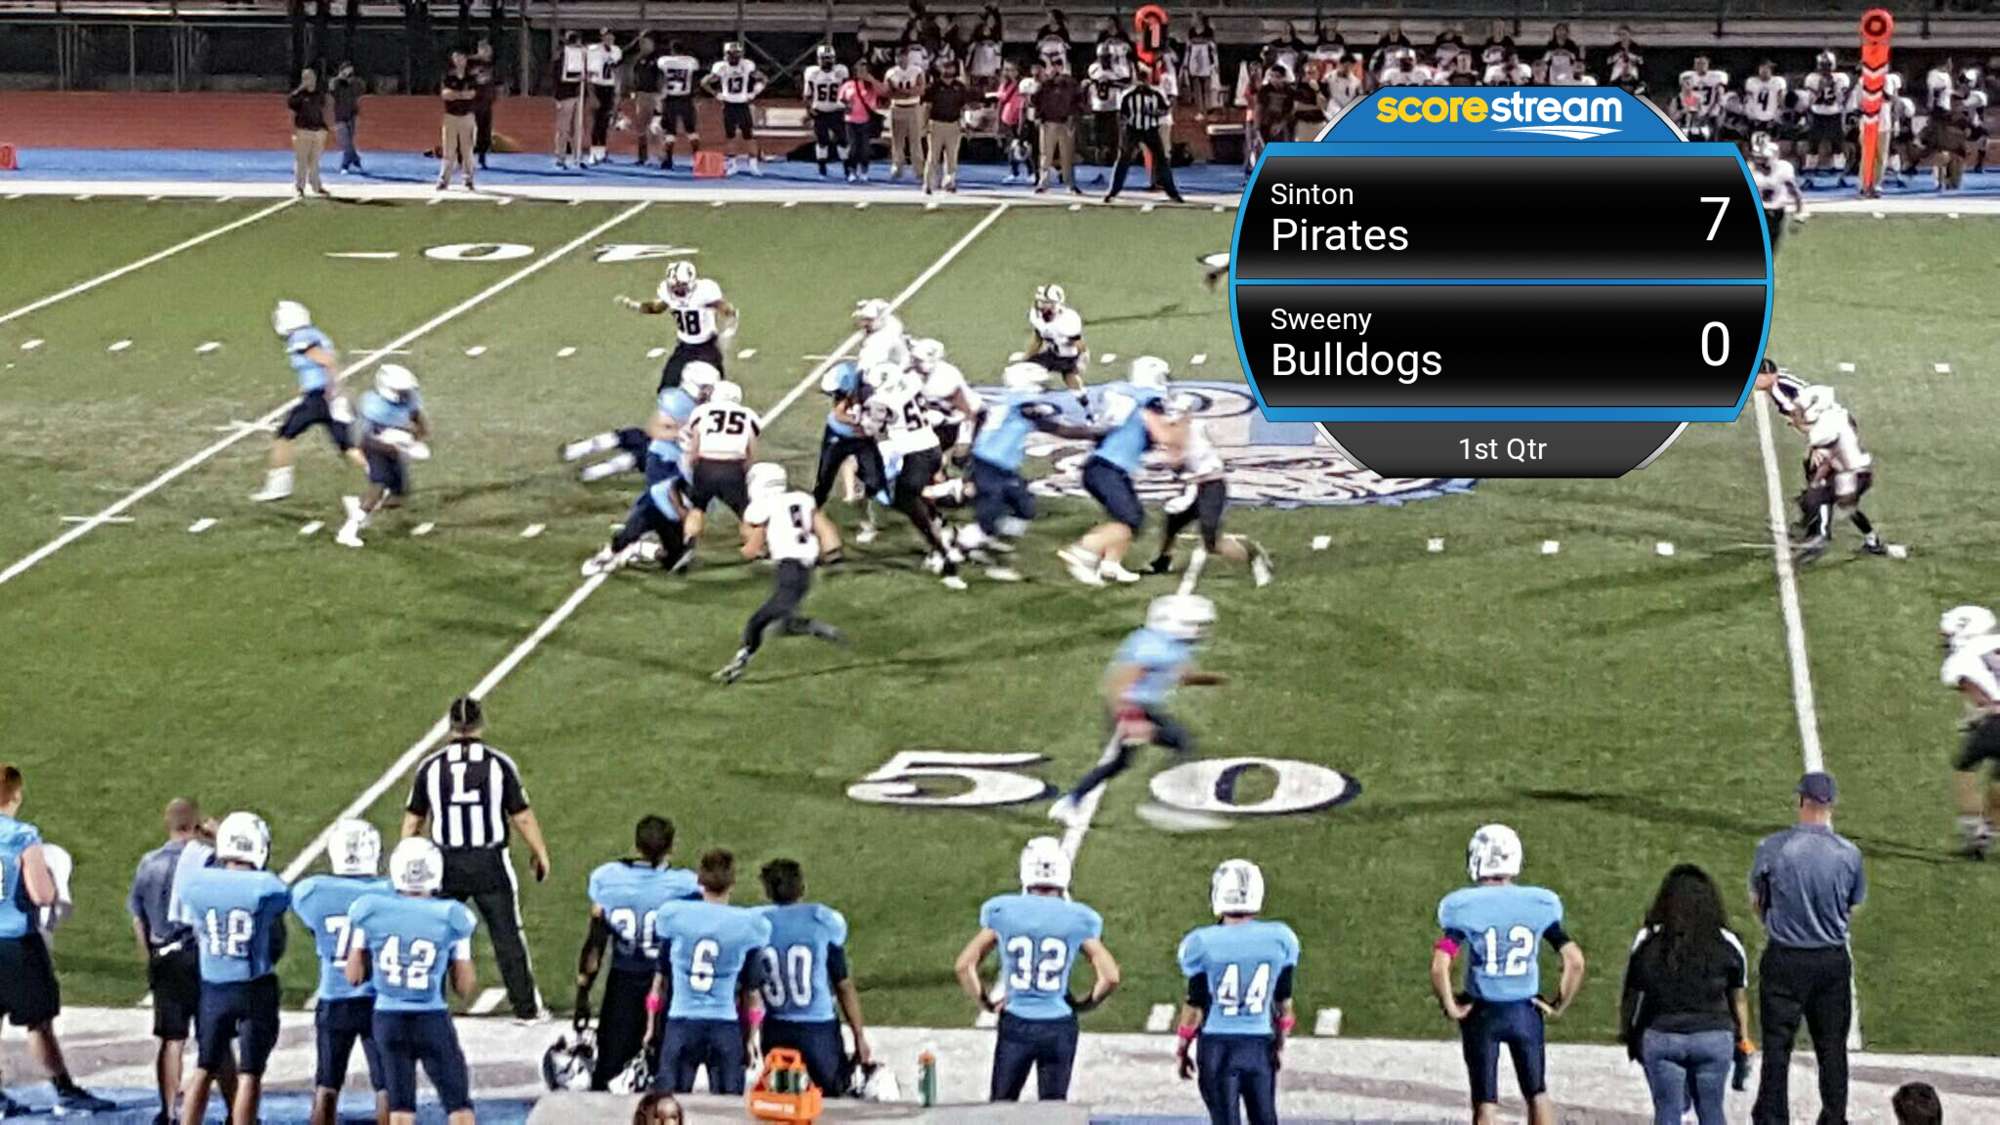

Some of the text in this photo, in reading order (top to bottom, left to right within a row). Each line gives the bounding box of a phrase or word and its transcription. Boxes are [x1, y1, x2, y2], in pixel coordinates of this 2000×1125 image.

[706, 409, 747, 435] 35
[445, 762, 480, 803] L
[379, 935, 437, 990] 42
[689, 938, 720, 993] 6
[1007, 935, 1068, 992] 32
[1484, 925, 1534, 976] 12
[1217, 963, 1270, 1016] 44
